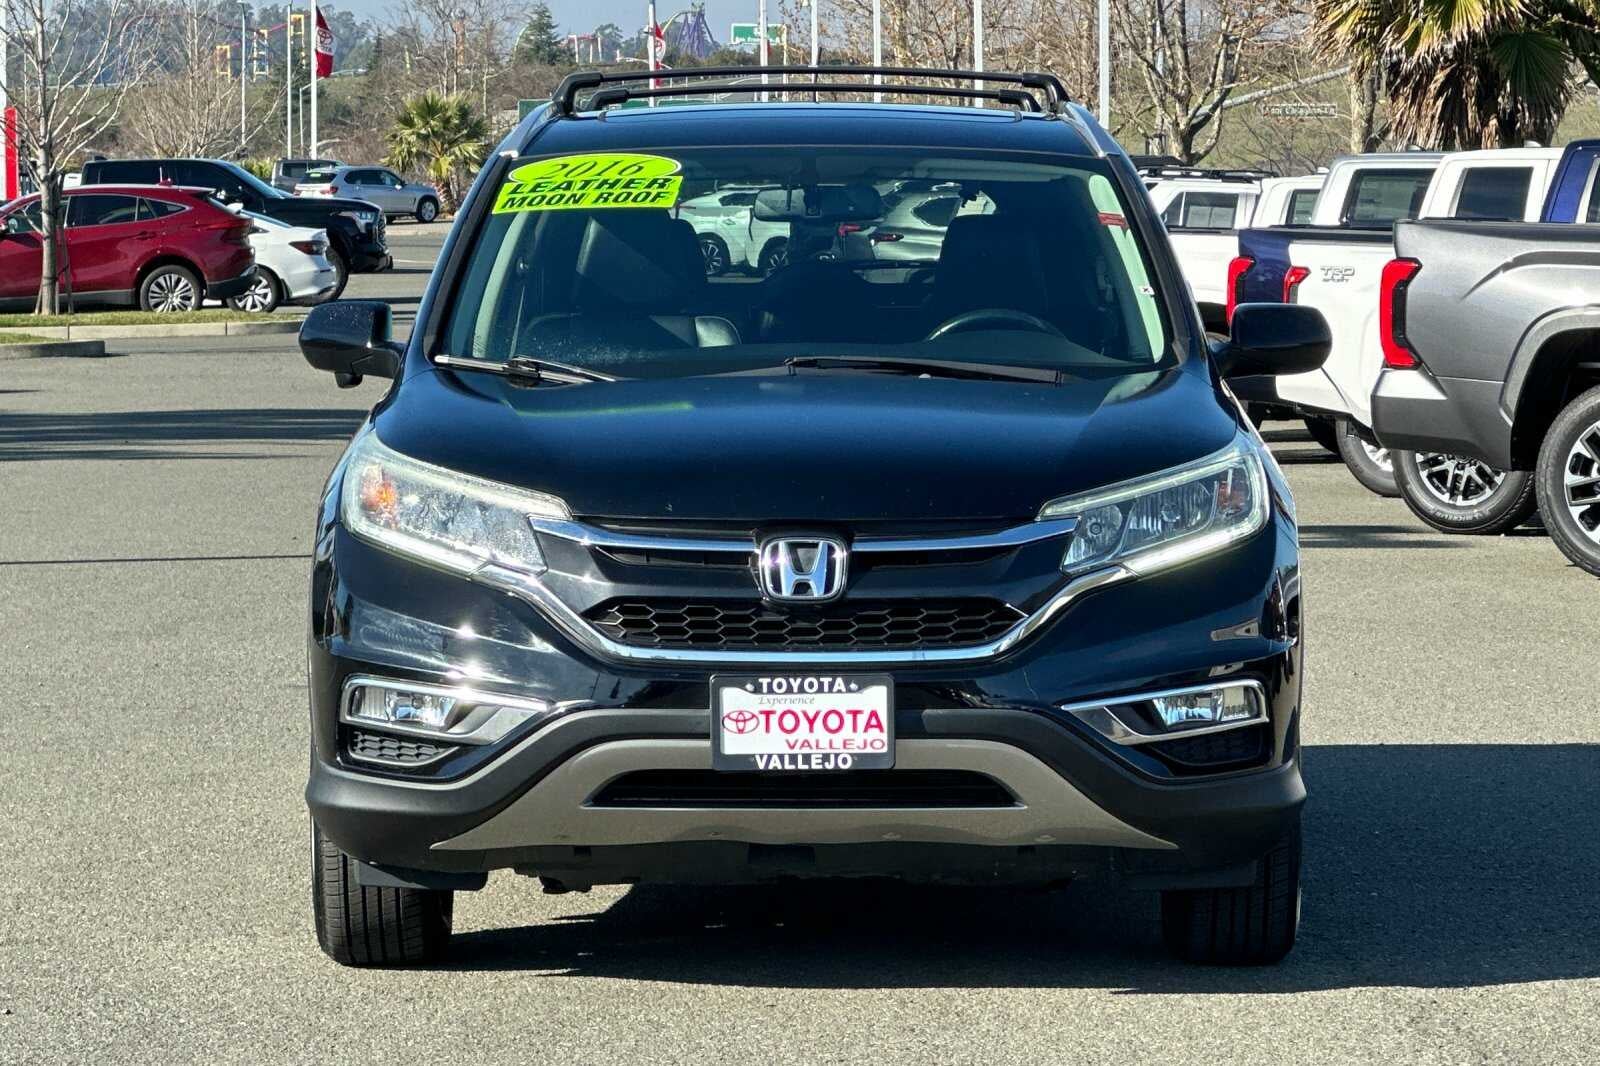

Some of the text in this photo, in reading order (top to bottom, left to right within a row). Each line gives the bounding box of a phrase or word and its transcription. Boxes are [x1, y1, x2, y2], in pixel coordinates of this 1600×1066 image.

[535, 159, 656, 180] 2016
[508, 176, 672, 195] LEATHER
[501, 190, 670, 209] MOON ROOF
[758, 677, 847, 694] TOYOTA
[758, 695, 816, 707] Experience
[758, 709, 885, 735] TOYOTA
[784, 738, 886, 750] VALLEJO
[753, 753, 853, 770] VALLEJO
